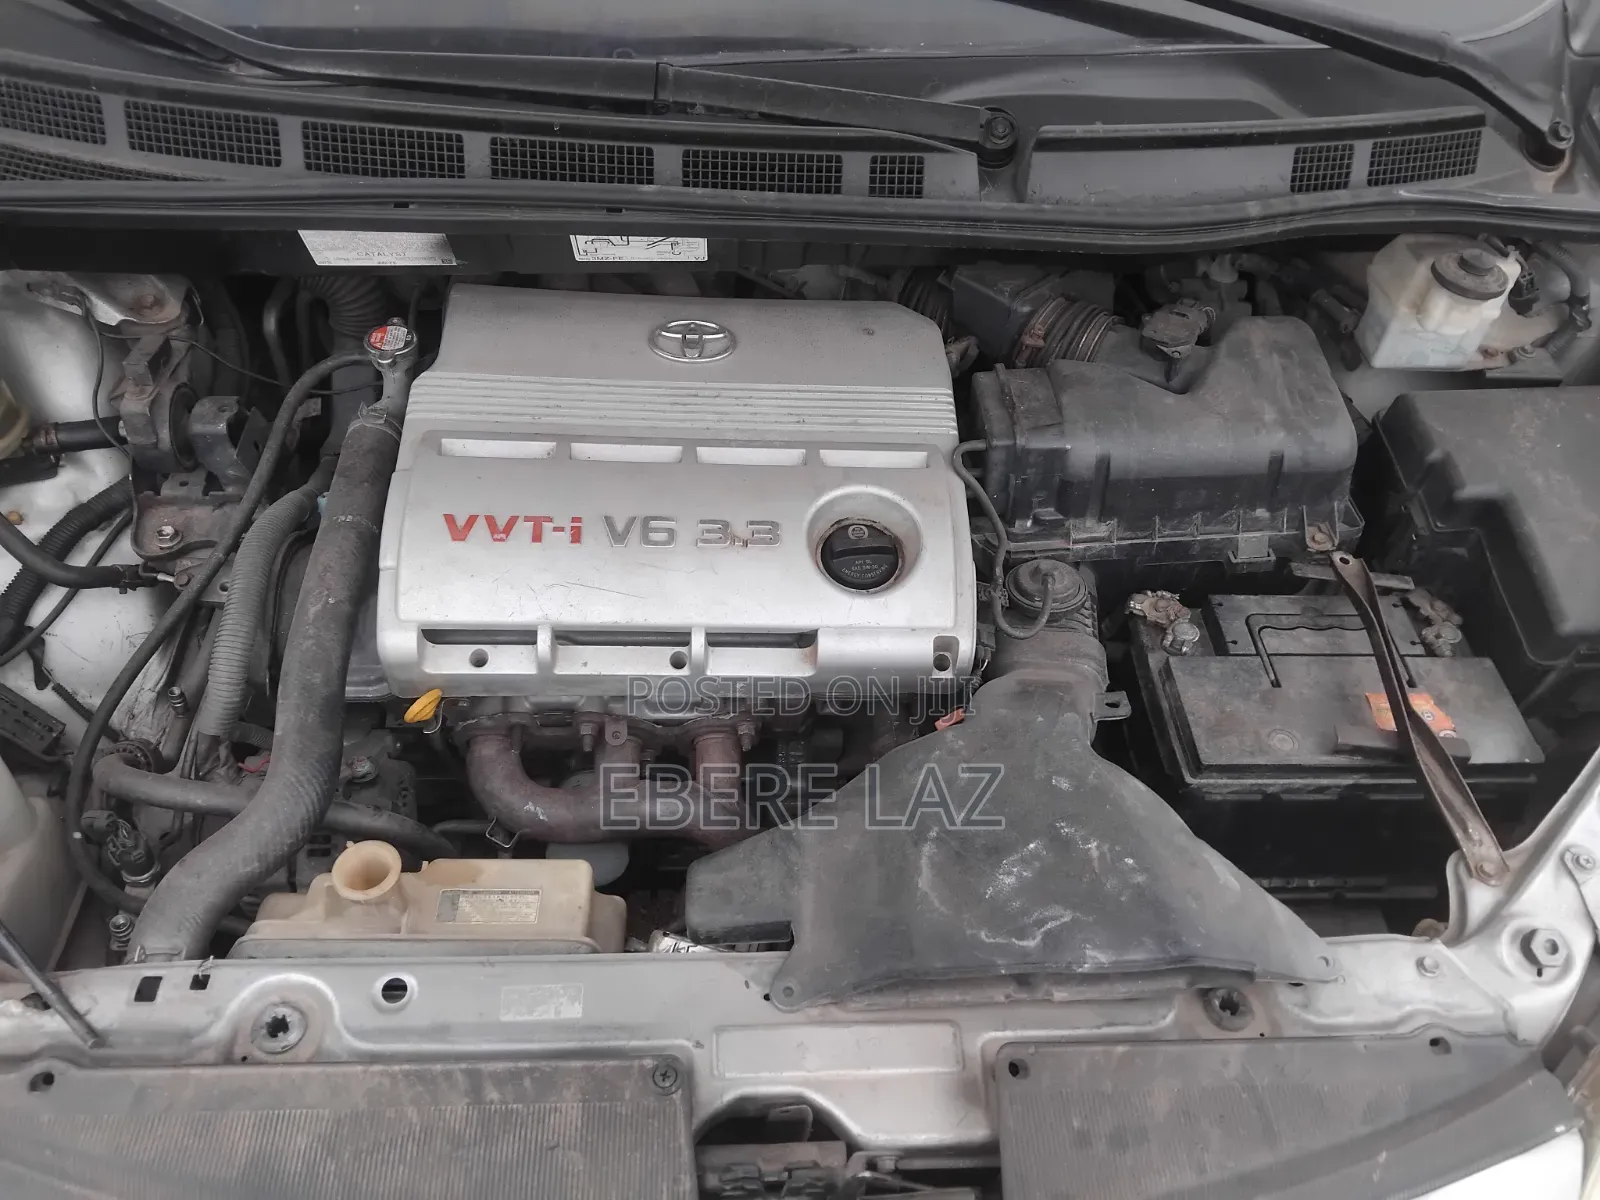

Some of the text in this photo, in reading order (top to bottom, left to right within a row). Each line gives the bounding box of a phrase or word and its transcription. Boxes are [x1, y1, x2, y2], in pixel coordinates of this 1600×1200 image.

[442, 513, 783, 549] VVT-i V6 3.3
[841, 567, 861, 578] ENERGY
